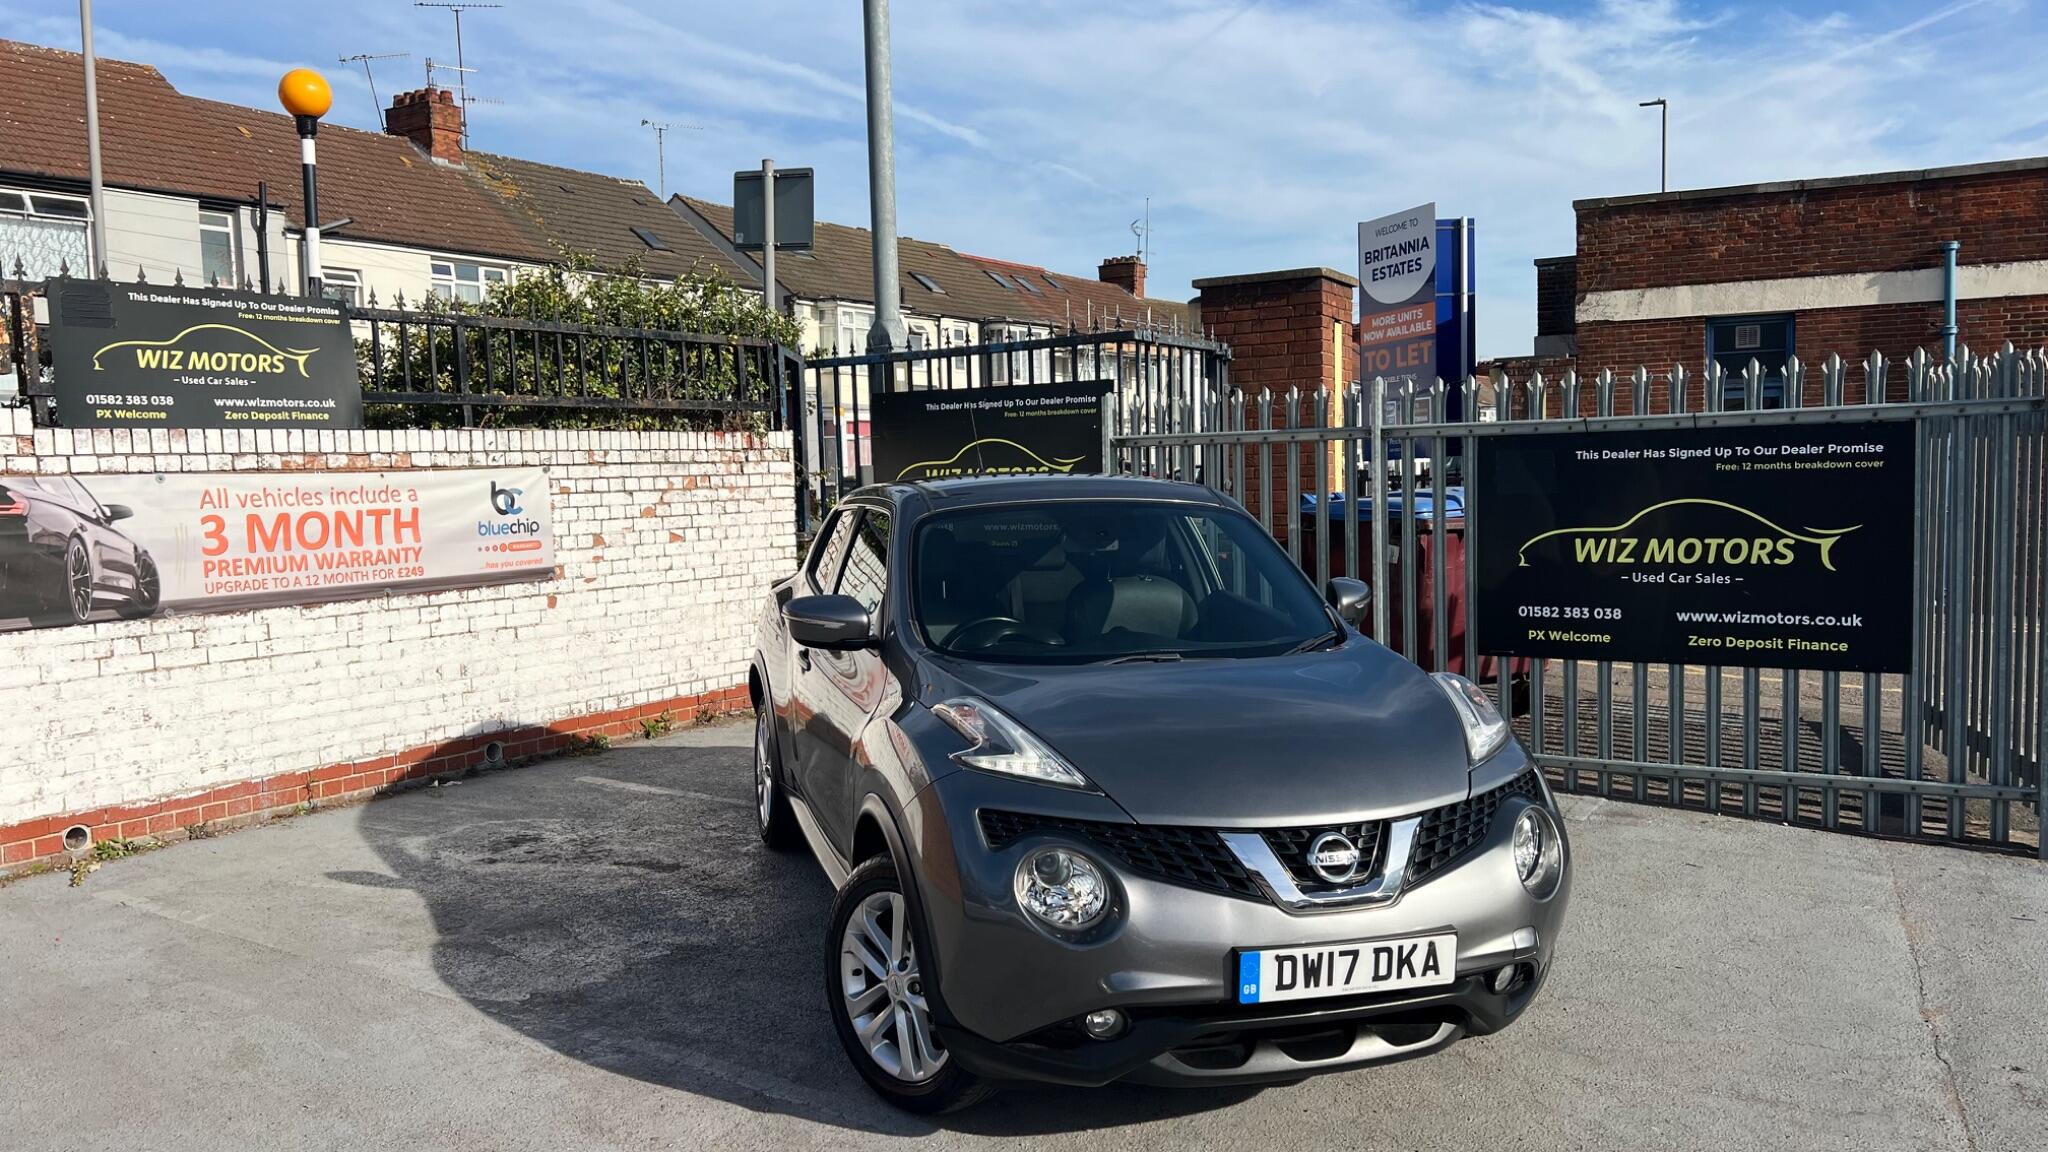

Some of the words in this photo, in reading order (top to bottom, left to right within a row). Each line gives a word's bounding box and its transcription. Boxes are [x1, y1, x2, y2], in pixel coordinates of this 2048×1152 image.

[1375, 221, 1407, 237] WELCOME
[1410, 218, 1418, 227] TO
[1364, 236, 1430, 265] BRITANNIA
[1372, 257, 1422, 282] ESTATES
[128, 292, 148, 302] This
[150, 294, 180, 304] Dealer
[182, 296, 200, 305] Has
[201, 298, 233, 308] Signed
[234, 300, 247, 310] Up
[248, 302, 259, 310] To
[261, 303, 276, 311] Our
[278, 304, 305, 313] Dealer
[307, 306, 340, 315] Promise
[263, 314, 288, 322] months
[288, 316, 323, 324] breakdown
[1371, 314, 1396, 328] MORE
[1397, 309, 1423, 322] UNITS
[1363, 329, 1385, 342] NOW
[1386, 320, 1432, 337] AVAILABLE
[136, 348, 184, 370] WIZ
[188, 351, 285, 373] MOTORS
[1364, 348, 1391, 372] TO
[1396, 341, 1432, 368] LET
[181, 376, 205, 385] Used
[207, 377, 222, 385] Car
[225, 377, 248, 386] Sales
[86, 394, 123, 405] 01582
[125, 395, 148, 405] 383
[151, 395, 174, 406] 038
[214, 397, 336, 408] www.wizmotors.co.uk
[925, 403, 940, 411] This
[940, 402, 962, 410] Dealer
[978, 400, 1003, 410] Signed
[1004, 399, 1014, 408] Up
[1025, 398, 1038, 406] Our
[1040, 397, 1064, 405] Dealer
[1065, 395, 1097, 404] Promise
[96, 409, 112, 419] PX
[114, 409, 167, 419] Welcome
[224, 411, 249, 420] Zero
[250, 411, 290, 422] Deposit
[291, 411, 330, 420] Finance
[1576, 450, 1599, 460] This
[1602, 449, 1640, 459] Dealer
[1643, 449, 1666, 458] Has
[1668, 447, 1712, 460] Signed
[1715, 447, 1732, 458] Up
[1735, 446, 1750, 456] To
[1753, 446, 1778, 455] Our
[1781, 444, 1825, 455] Dealer
[1827, 443, 1884, 454] Promise
[1741, 462, 1751, 470] 12
[1754, 461, 1792, 470] months
[1794, 460, 1852, 469] breakdown
[1854, 460, 1884, 468] cover
[200, 488, 229, 509] All
[236, 487, 324, 508] vehicles
[330, 484, 402, 505] include
[407, 488, 418, 502] a
[200, 514, 229, 556] 3
[246, 507, 421, 554] MONTH
[478, 518, 540, 537] bluechip
[1574, 537, 1639, 563] WIZ
[1643, 537, 1796, 564] MOTORS
[203, 554, 309, 578] PREMIUM
[313, 546, 422, 570] WARRANTY
[500, 560, 514, 569] you
[515, 557, 544, 567] covered
[205, 578, 269, 594] UPGRADE
[272, 577, 289, 589] TO
[293, 576, 302, 588] A
[305, 574, 320, 586] 12
[323, 570, 369, 585] MONTH
[372, 568, 395, 580] FOR
[397, 566, 425, 578] £249
[1632, 572, 1665, 583] Used
[1668, 573, 1691, 583] Car
[1695, 573, 1731, 584] Sales
[1518, 606, 1560, 618] 01582
[1563, 607, 1590, 619] 383
[1594, 608, 1622, 620] 038
[1676, 611, 1863, 627] www.wizmotors.co.uk
[1528, 629, 1546, 640] PX
[1548, 630, 1611, 643] Welcome
[1688, 635, 1722, 647] Zero
[1726, 636, 1783, 650] Deposit
[1788, 638, 1849, 651] Finance
[1274, 948, 1360, 992] DW17
[1371, 940, 1441, 983] DKA
[1243, 983, 1257, 995] GB
